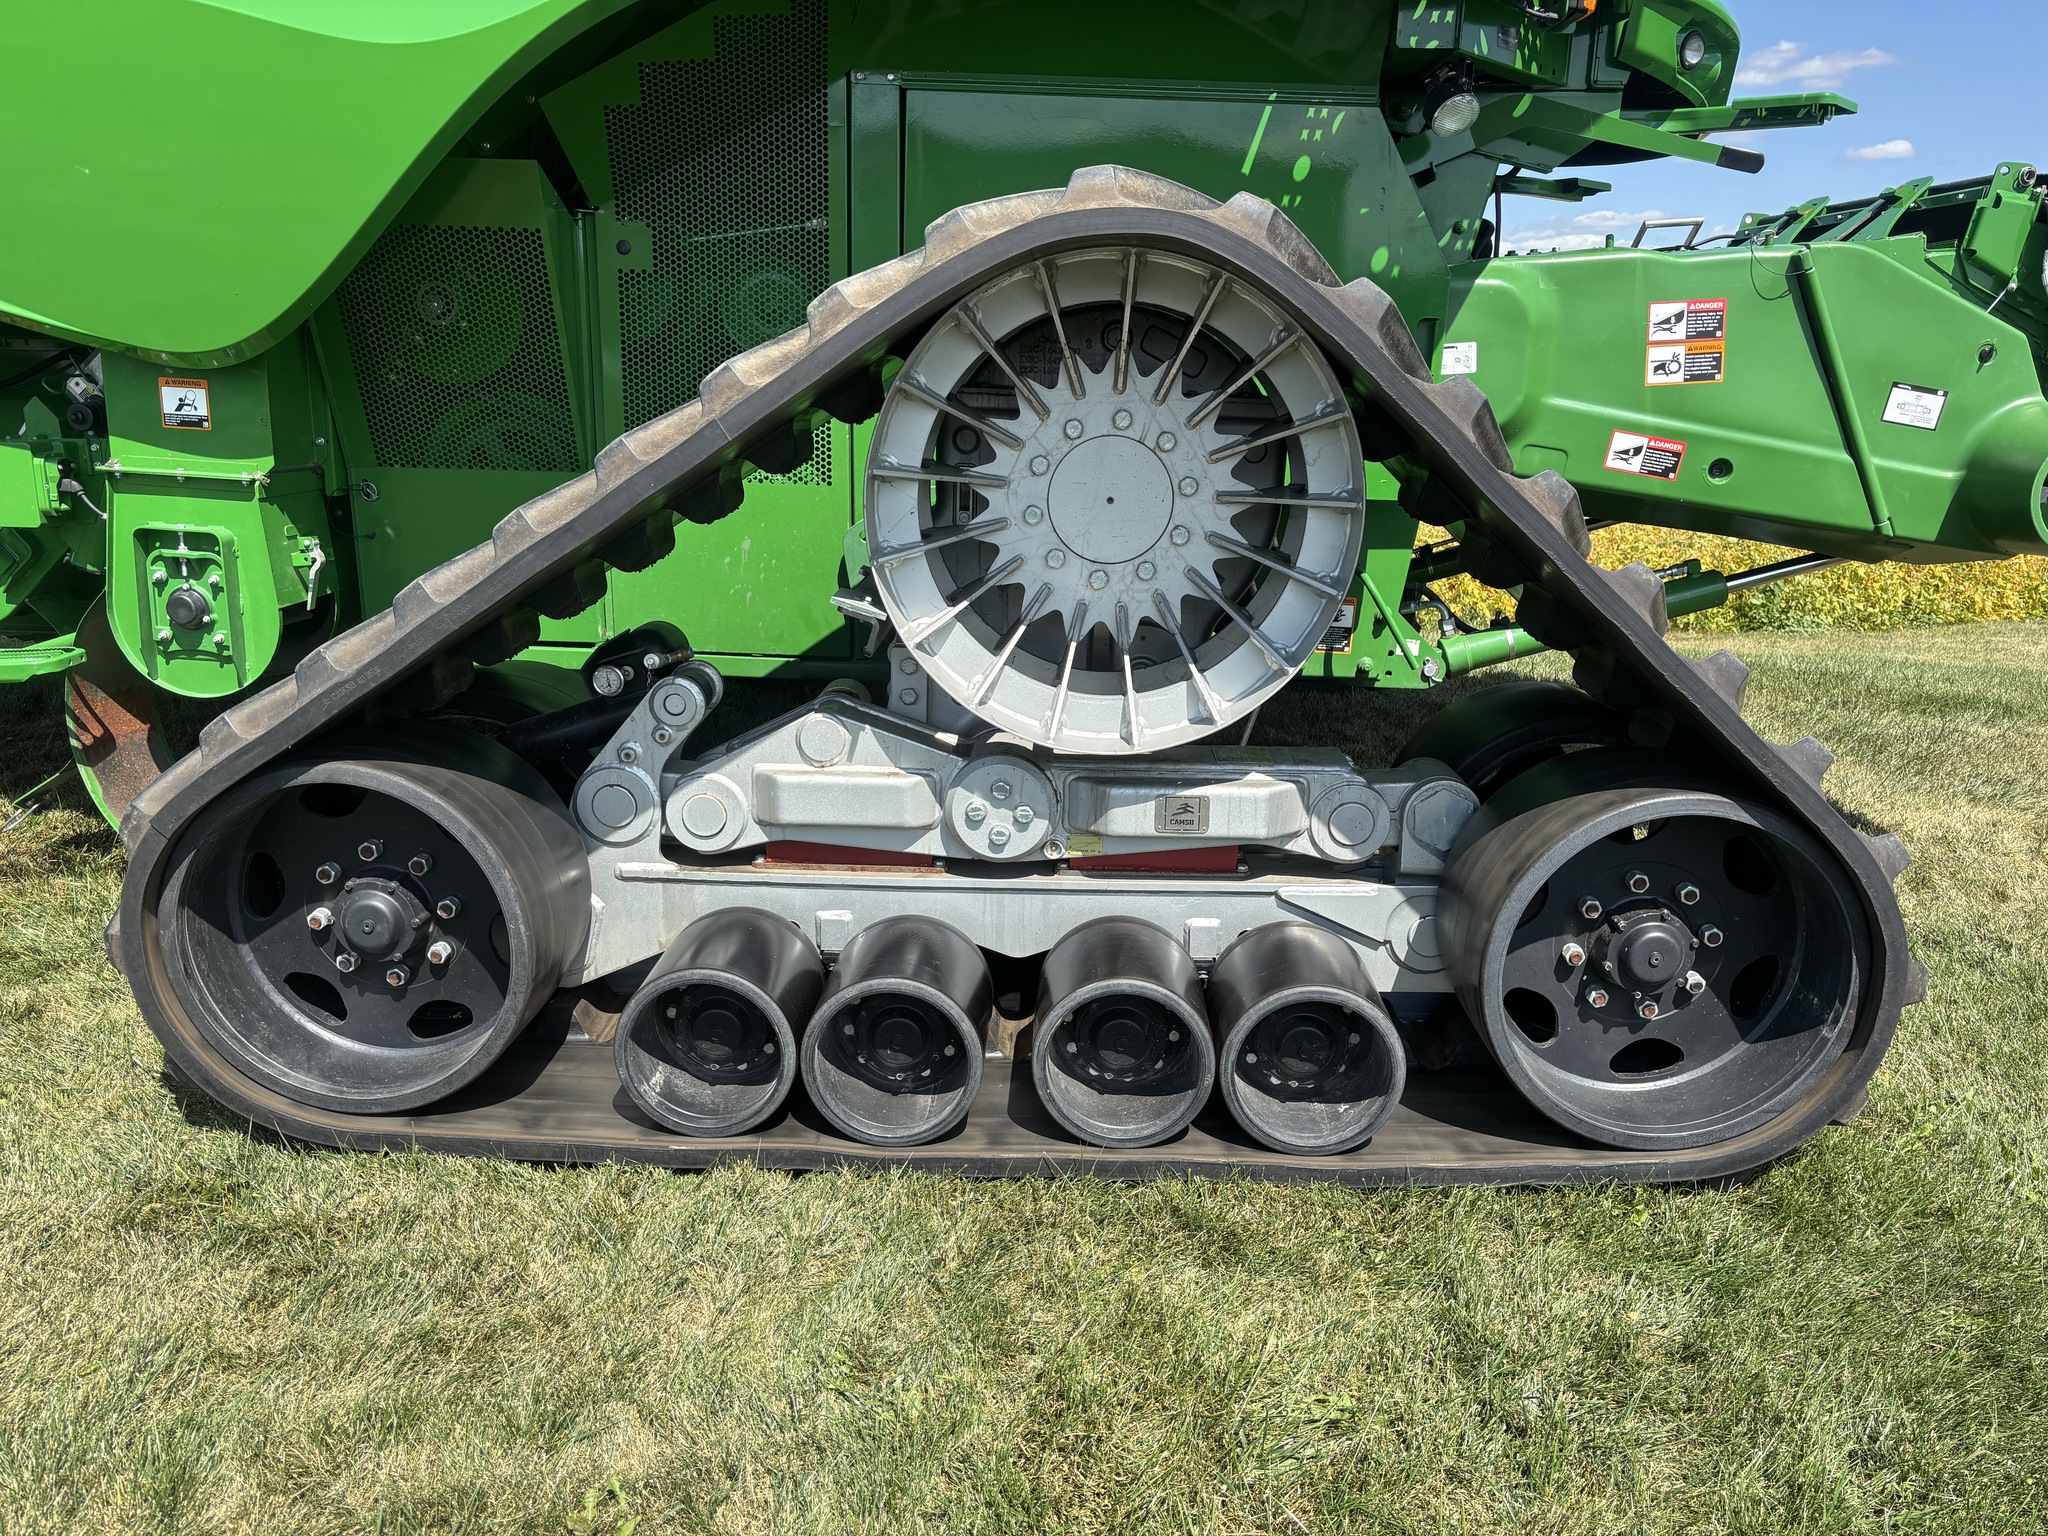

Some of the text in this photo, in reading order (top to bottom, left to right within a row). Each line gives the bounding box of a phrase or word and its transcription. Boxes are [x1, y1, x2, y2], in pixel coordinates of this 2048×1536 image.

[1695, 301, 1723, 310] DANGER
[172, 379, 202, 387] WARNING
[1655, 441, 1684, 451] DANGER
[330, 681, 357, 701] CAMSO
[1169, 818, 1195, 826] CAMSO
